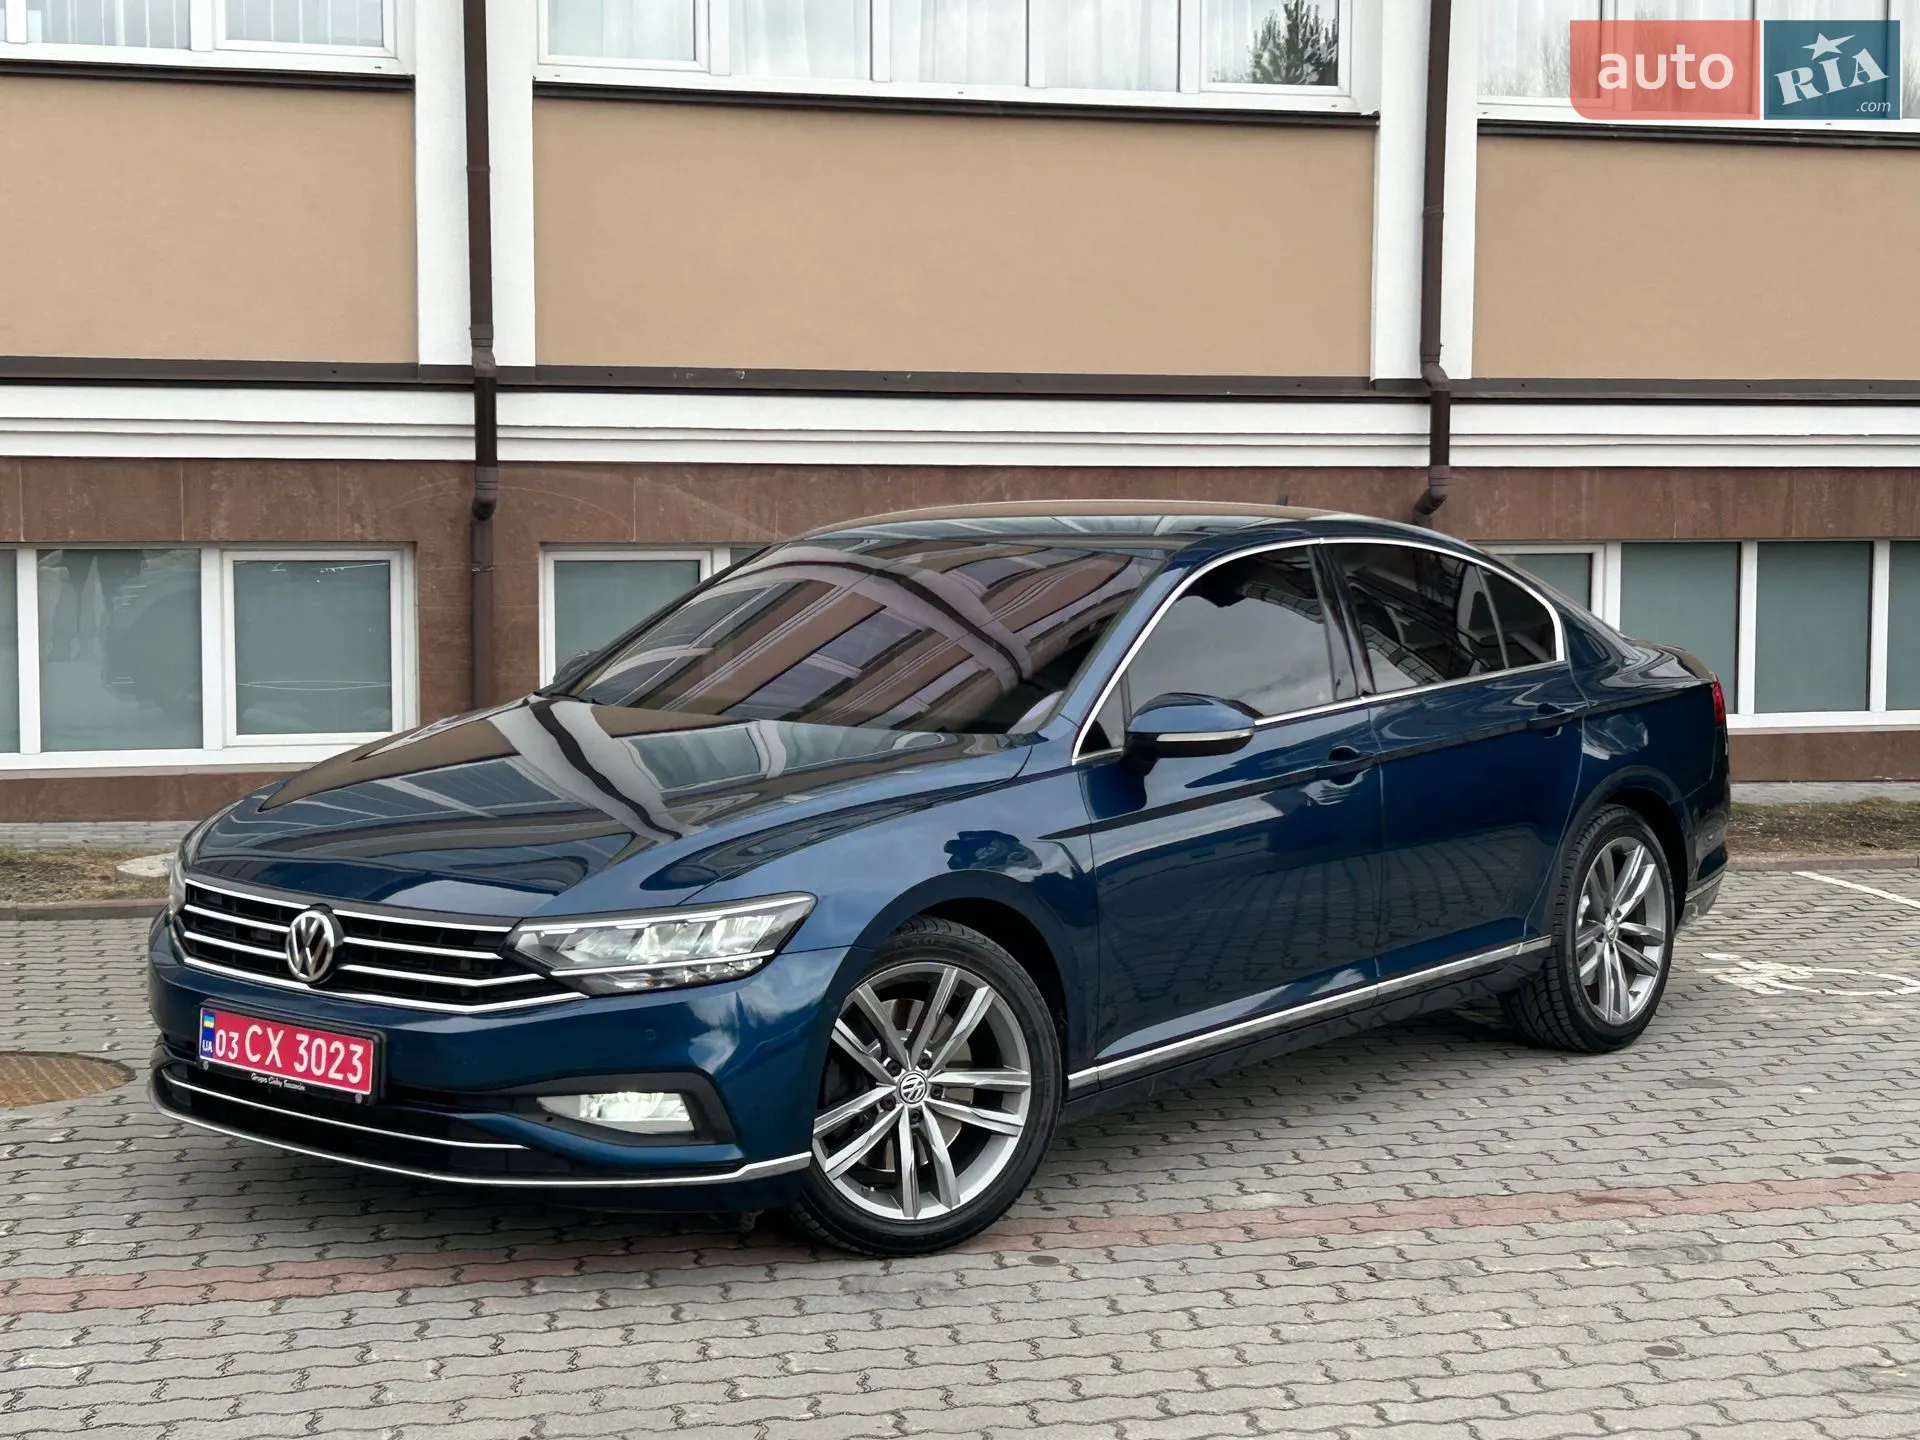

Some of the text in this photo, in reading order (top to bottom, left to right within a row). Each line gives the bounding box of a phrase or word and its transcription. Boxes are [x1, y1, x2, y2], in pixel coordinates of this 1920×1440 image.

[203, 1039, 213, 1053] UA
[216, 1024, 364, 1084] 03 CX 3023
